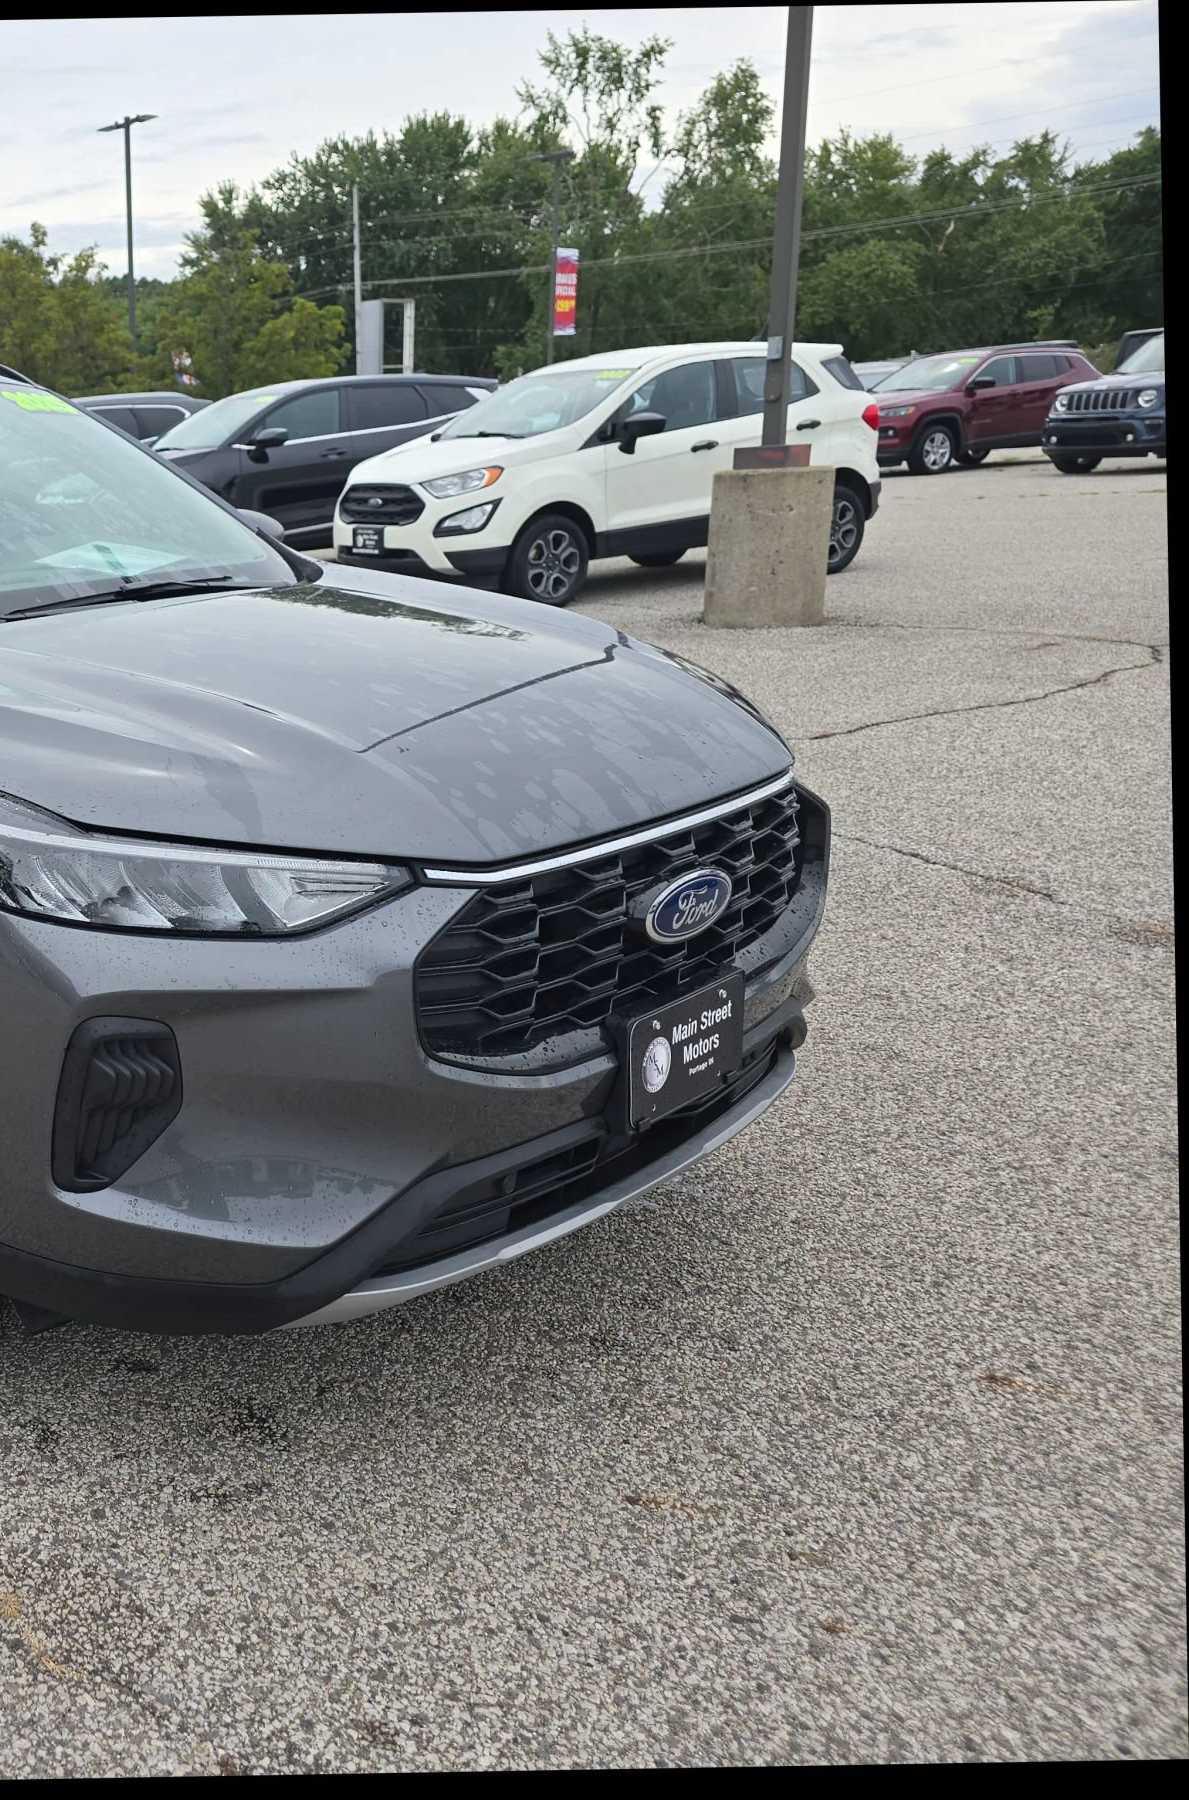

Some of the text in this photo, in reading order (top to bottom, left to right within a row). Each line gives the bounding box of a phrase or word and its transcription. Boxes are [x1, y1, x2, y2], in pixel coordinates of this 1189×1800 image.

[672, 885, 719, 930] Ford
[672, 1000, 733, 1045] Main Street
[683, 1033, 720, 1065] Motors
[688, 1061, 708, 1077] Portage
